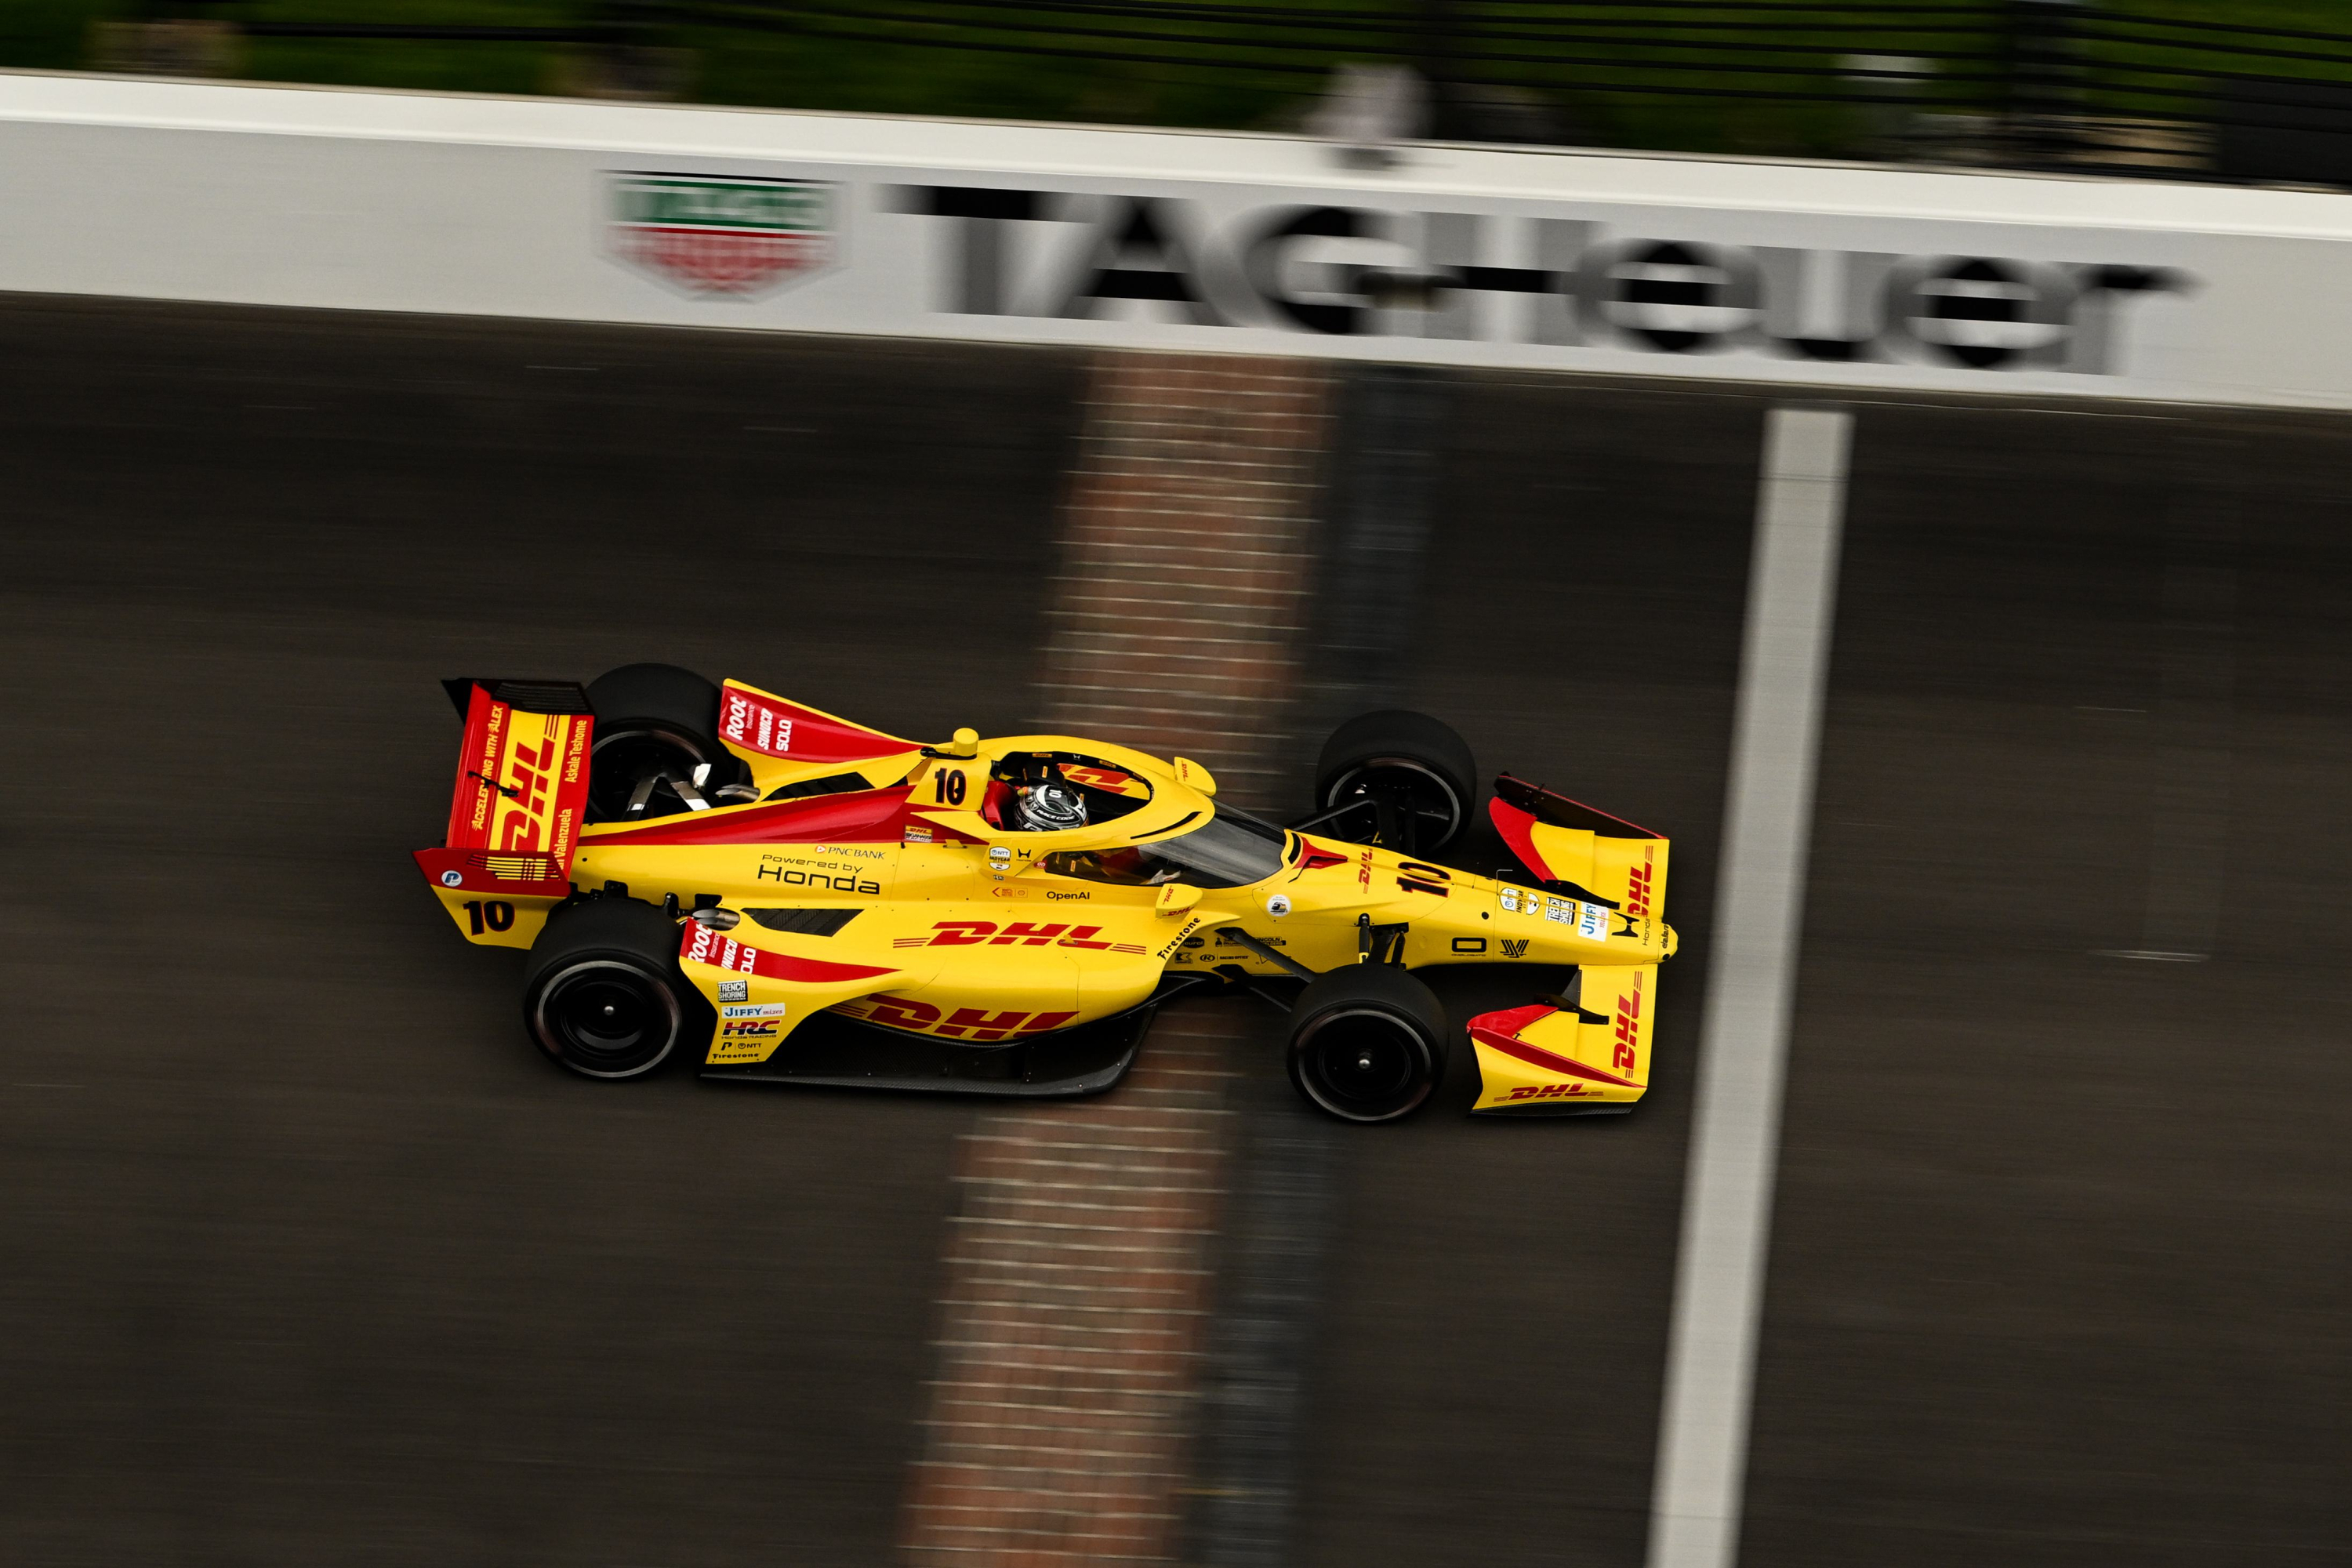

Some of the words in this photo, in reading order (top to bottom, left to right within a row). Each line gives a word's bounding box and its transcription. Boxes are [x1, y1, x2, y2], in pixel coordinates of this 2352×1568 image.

[488, 705, 503, 732] ALEX
[757, 707, 773, 750] SUNOCO
[485, 734, 498, 757] WITH
[569, 720, 587, 755] Teshome
[776, 719, 792, 752] SOLO
[564, 755, 580, 782] Askale
[499, 737, 556, 851] DHL
[934, 768, 967, 806] 10
[1049, 789, 1062, 798] 10
[554, 808, 572, 858] Valenzuela
[762, 854, 838, 869] Powered
[842, 863, 863, 874] by
[828, 847, 853, 857] PNC
[854, 849, 886, 860] BANK
[757, 864, 880, 895] Honda
[1396, 862, 1451, 898] 10
[1628, 862, 1652, 917] DHL
[1047, 891, 1090, 901] OpenAI
[463, 901, 516, 936] 10
[927, 921, 1113, 949] DHL
[1156, 916, 1201, 960] Firestone
[740, 947, 756, 975] OLO
[718, 982, 746, 992] TRENCH
[724, 1007, 762, 1017] JIFFY
[866, 993, 1081, 1040] DHL
[722, 1019, 782, 1036] HRC
[1613, 989, 1640, 1070] DHL
[1508, 1083, 1589, 1100] DHL
